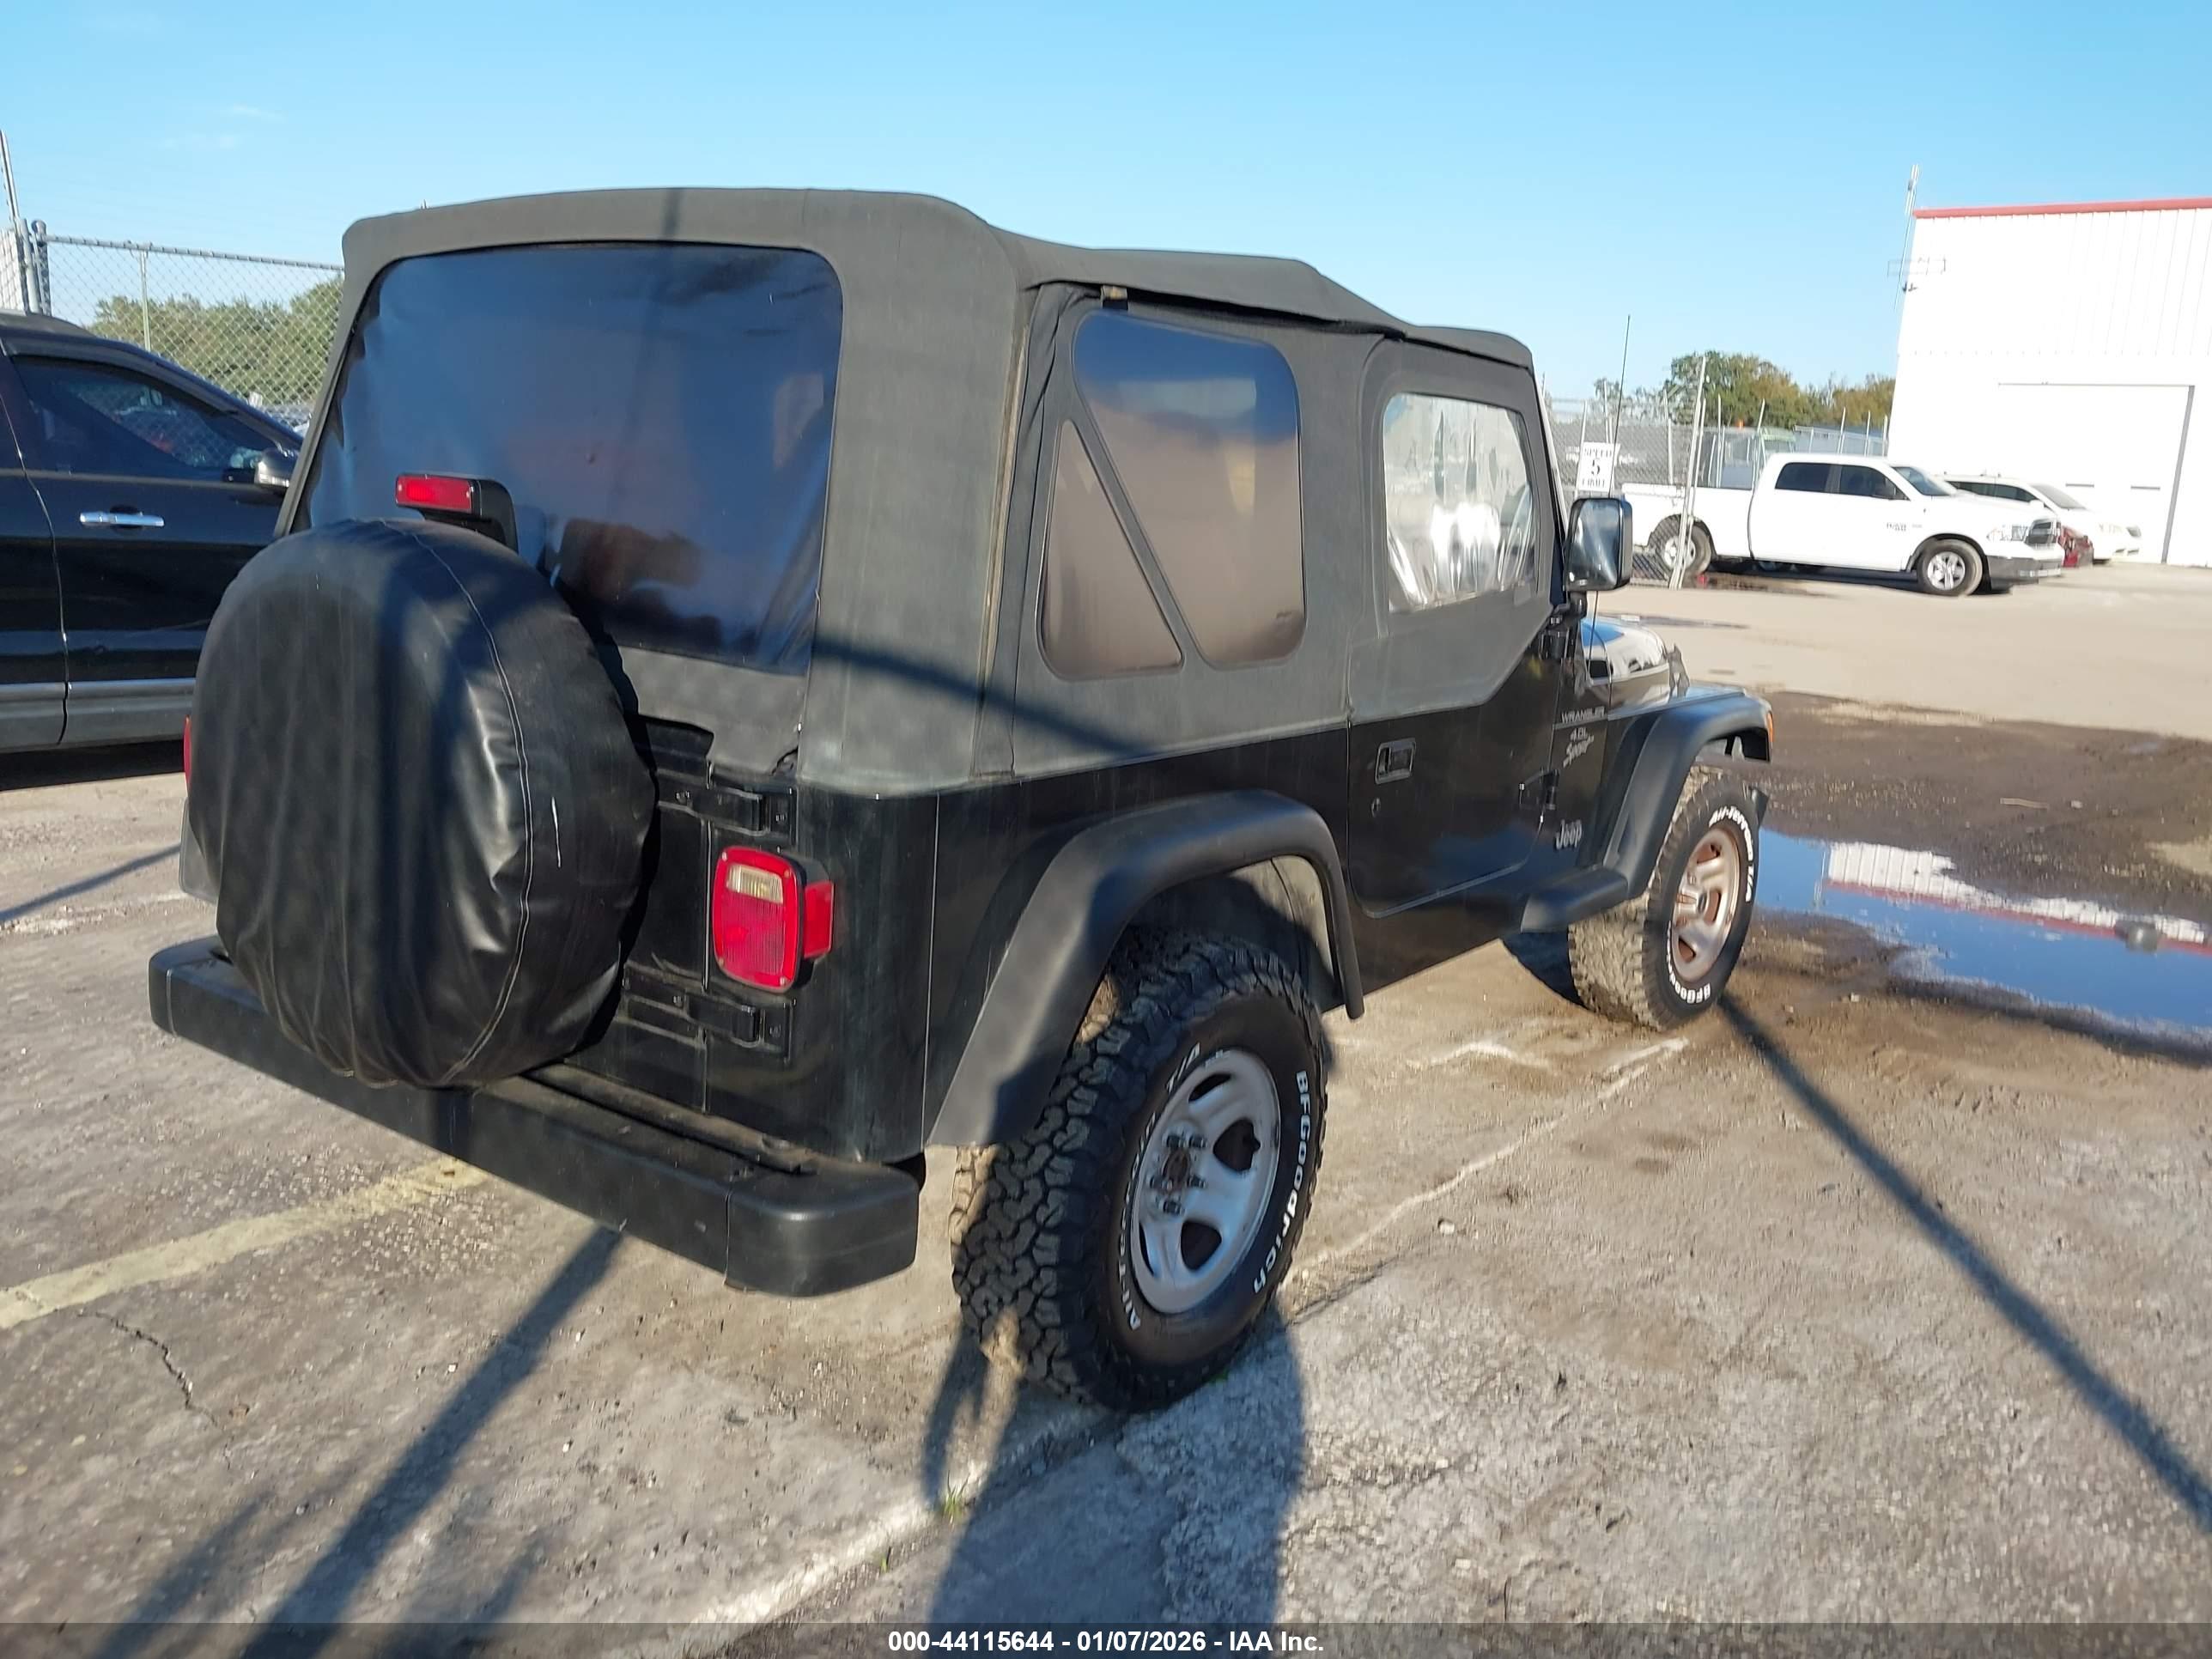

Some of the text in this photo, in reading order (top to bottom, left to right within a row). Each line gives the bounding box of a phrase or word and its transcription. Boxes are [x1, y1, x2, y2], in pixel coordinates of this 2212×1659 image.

[1590, 457, 1601, 475] 5
[1561, 706, 1606, 724] WRANGLER
[1556, 819, 1583, 849] Jeep
